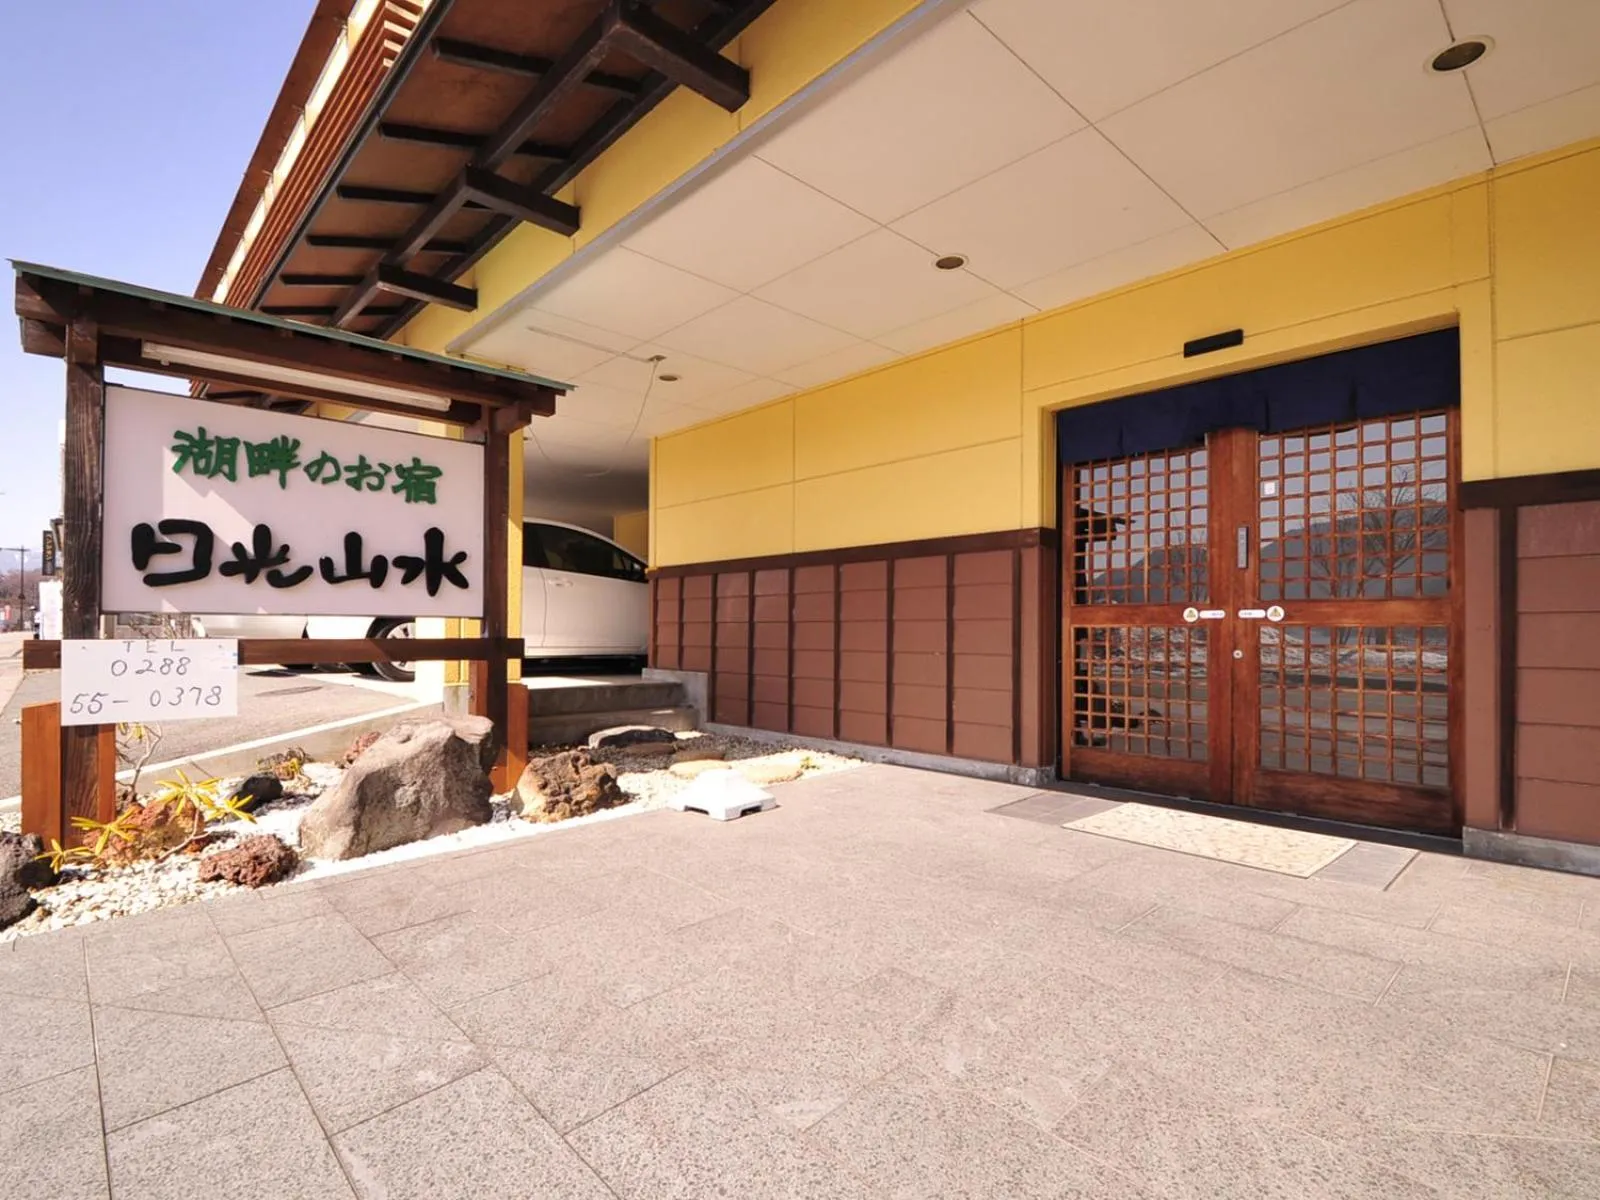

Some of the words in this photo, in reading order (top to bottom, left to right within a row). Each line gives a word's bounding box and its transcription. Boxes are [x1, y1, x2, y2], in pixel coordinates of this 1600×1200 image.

[172, 427, 443, 504] 湖畔のお宿
[131, 519, 470, 597] 日光山水
[110, 656, 192, 677] 0288
[122, 640, 185, 654] TEL
